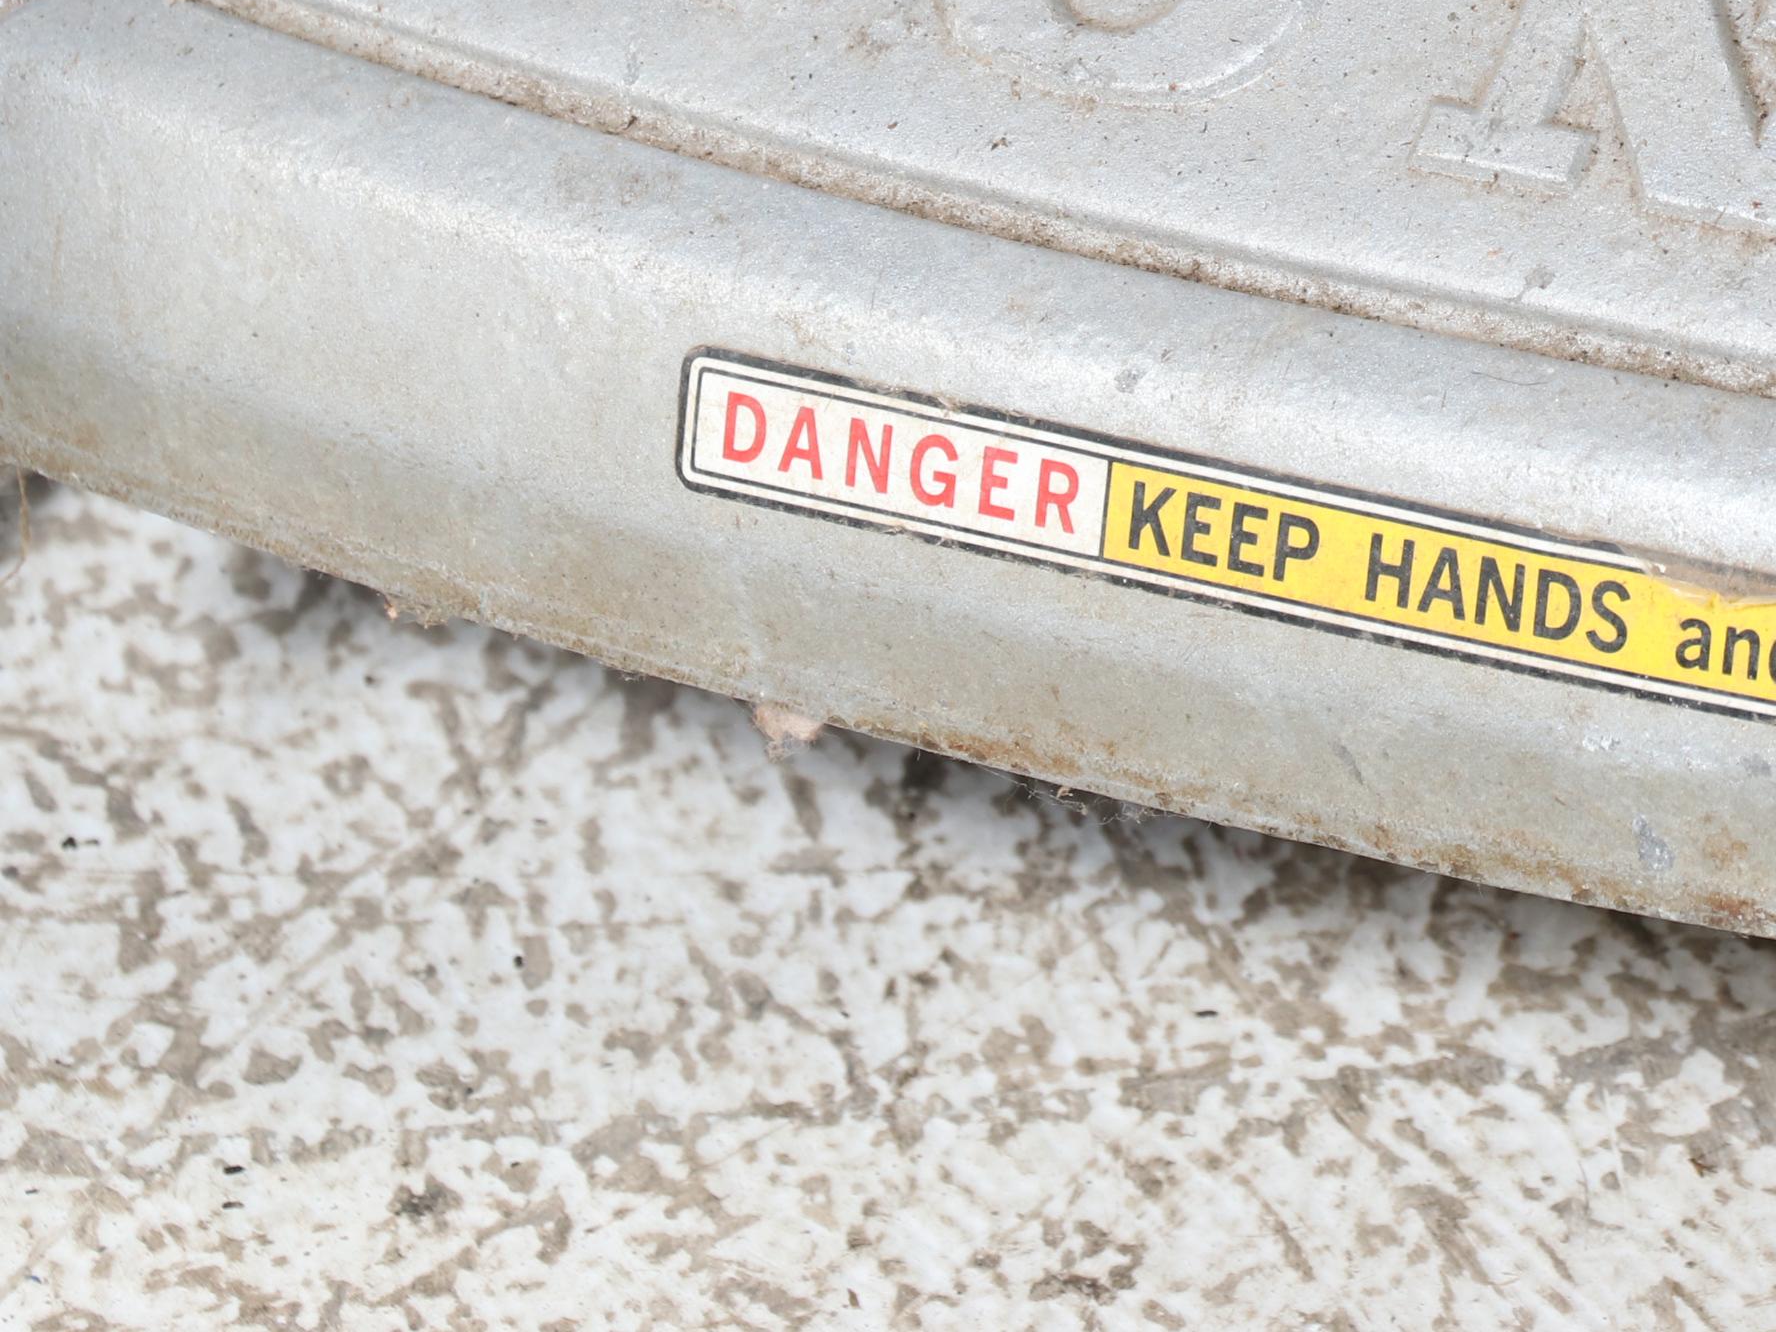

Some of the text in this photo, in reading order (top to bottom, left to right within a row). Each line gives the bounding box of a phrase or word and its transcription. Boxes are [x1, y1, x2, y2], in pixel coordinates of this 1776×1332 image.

[723, 391, 1080, 534] DANGER
[1127, 480, 1320, 582] KEEP
[1364, 533, 1633, 655] HANDS
